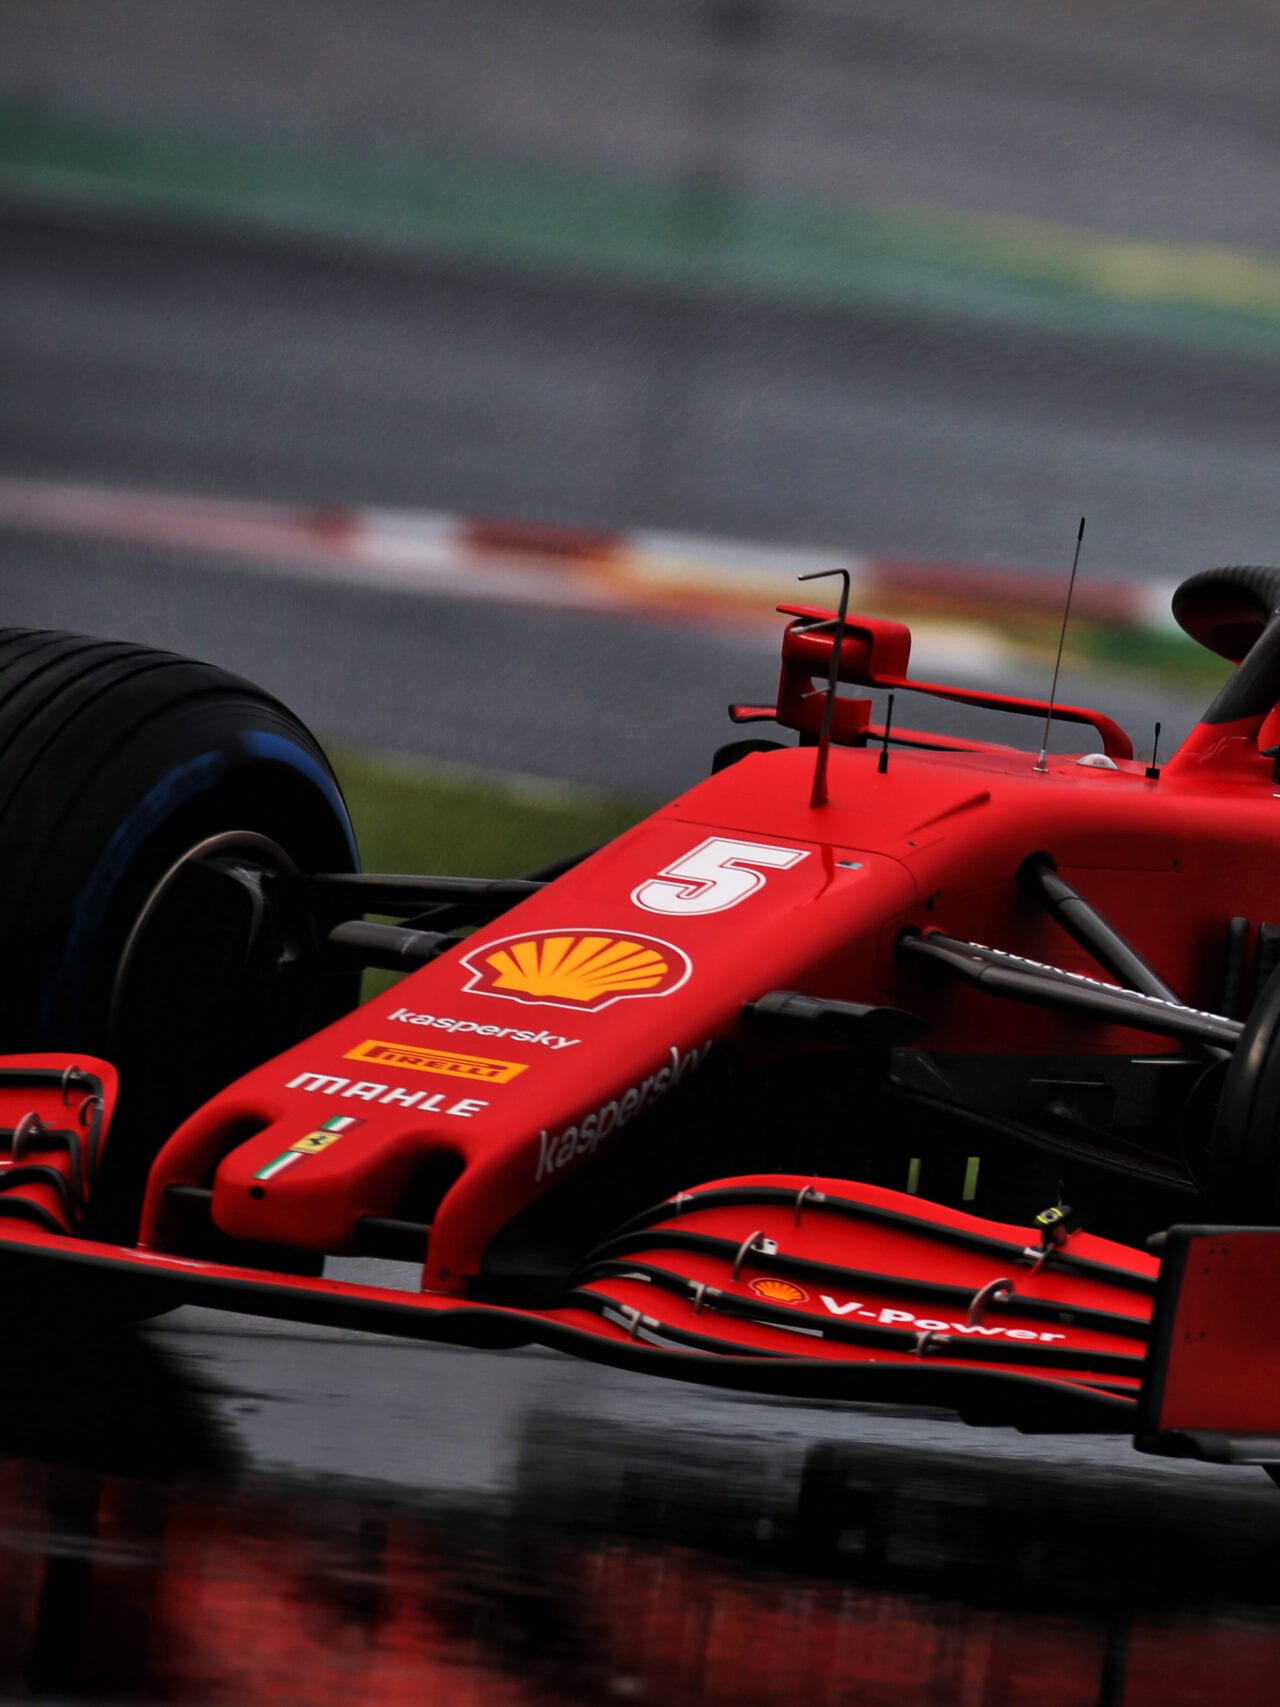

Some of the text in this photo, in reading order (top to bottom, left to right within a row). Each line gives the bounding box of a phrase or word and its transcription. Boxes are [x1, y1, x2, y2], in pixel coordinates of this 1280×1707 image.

[630, 836, 812, 916] 5
[387, 1008, 582, 1049] kaspersky
[362, 1046, 510, 1078] PIRELLI
[285, 1072, 490, 1118] MAHLE
[819, 1295, 1066, 1342] V-Power
